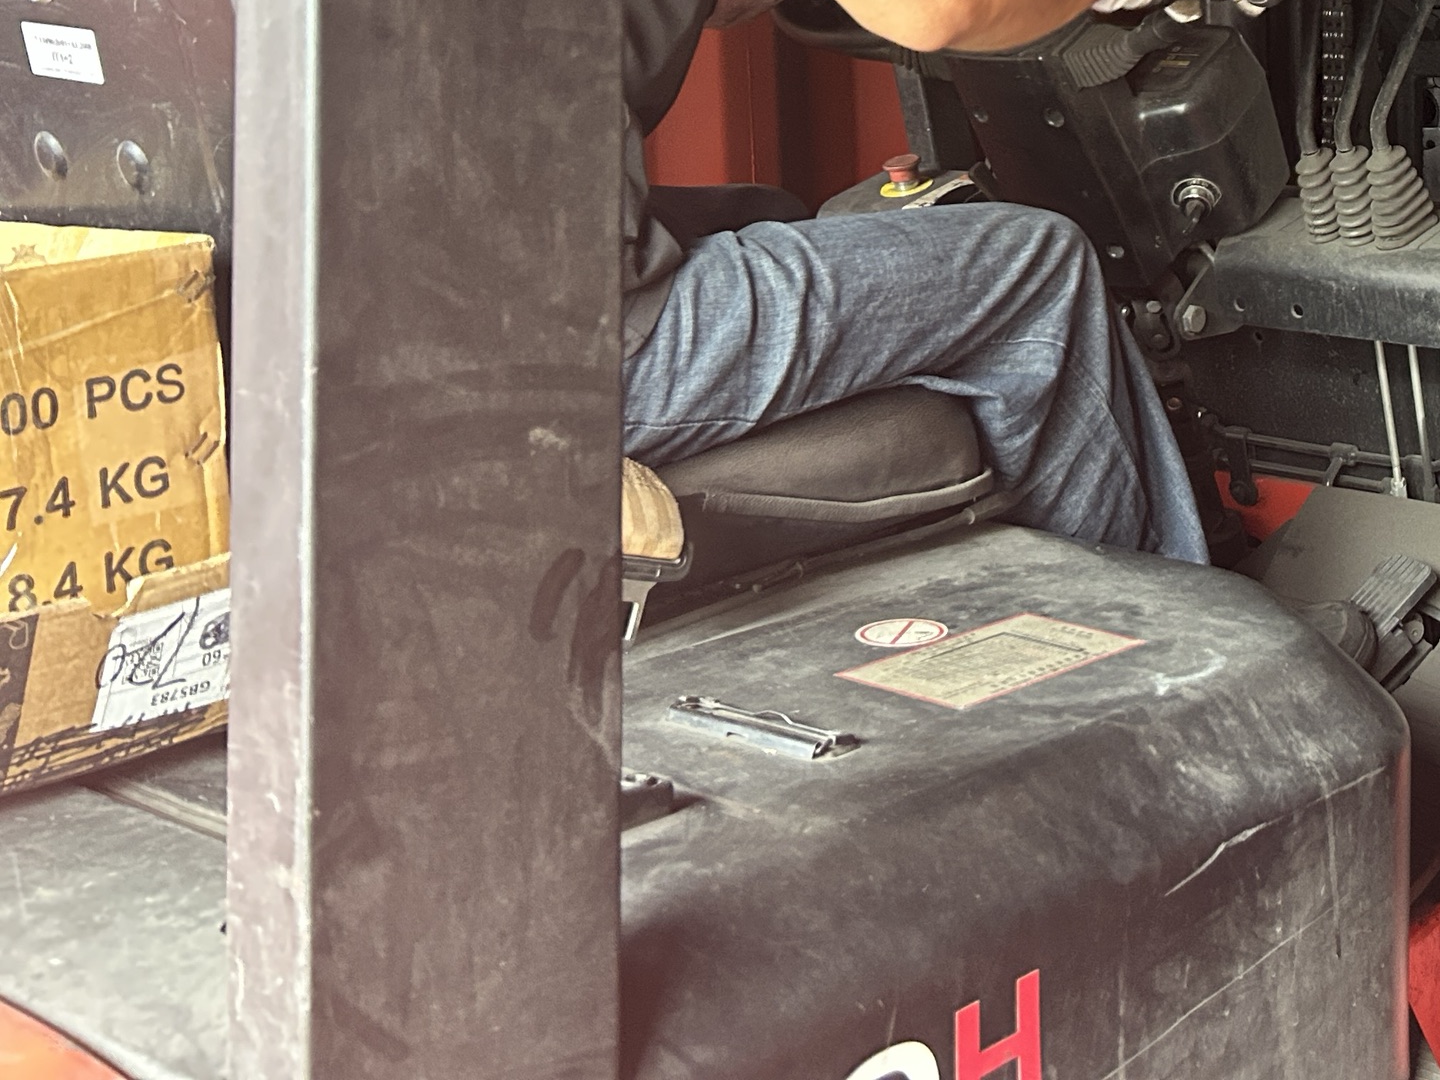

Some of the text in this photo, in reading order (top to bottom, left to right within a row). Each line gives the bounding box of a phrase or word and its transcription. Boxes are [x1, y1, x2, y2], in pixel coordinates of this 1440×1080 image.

[85, 362, 186, 419] PCS
[99, 455, 170, 509] KG
[104, 538, 174, 594] KG
